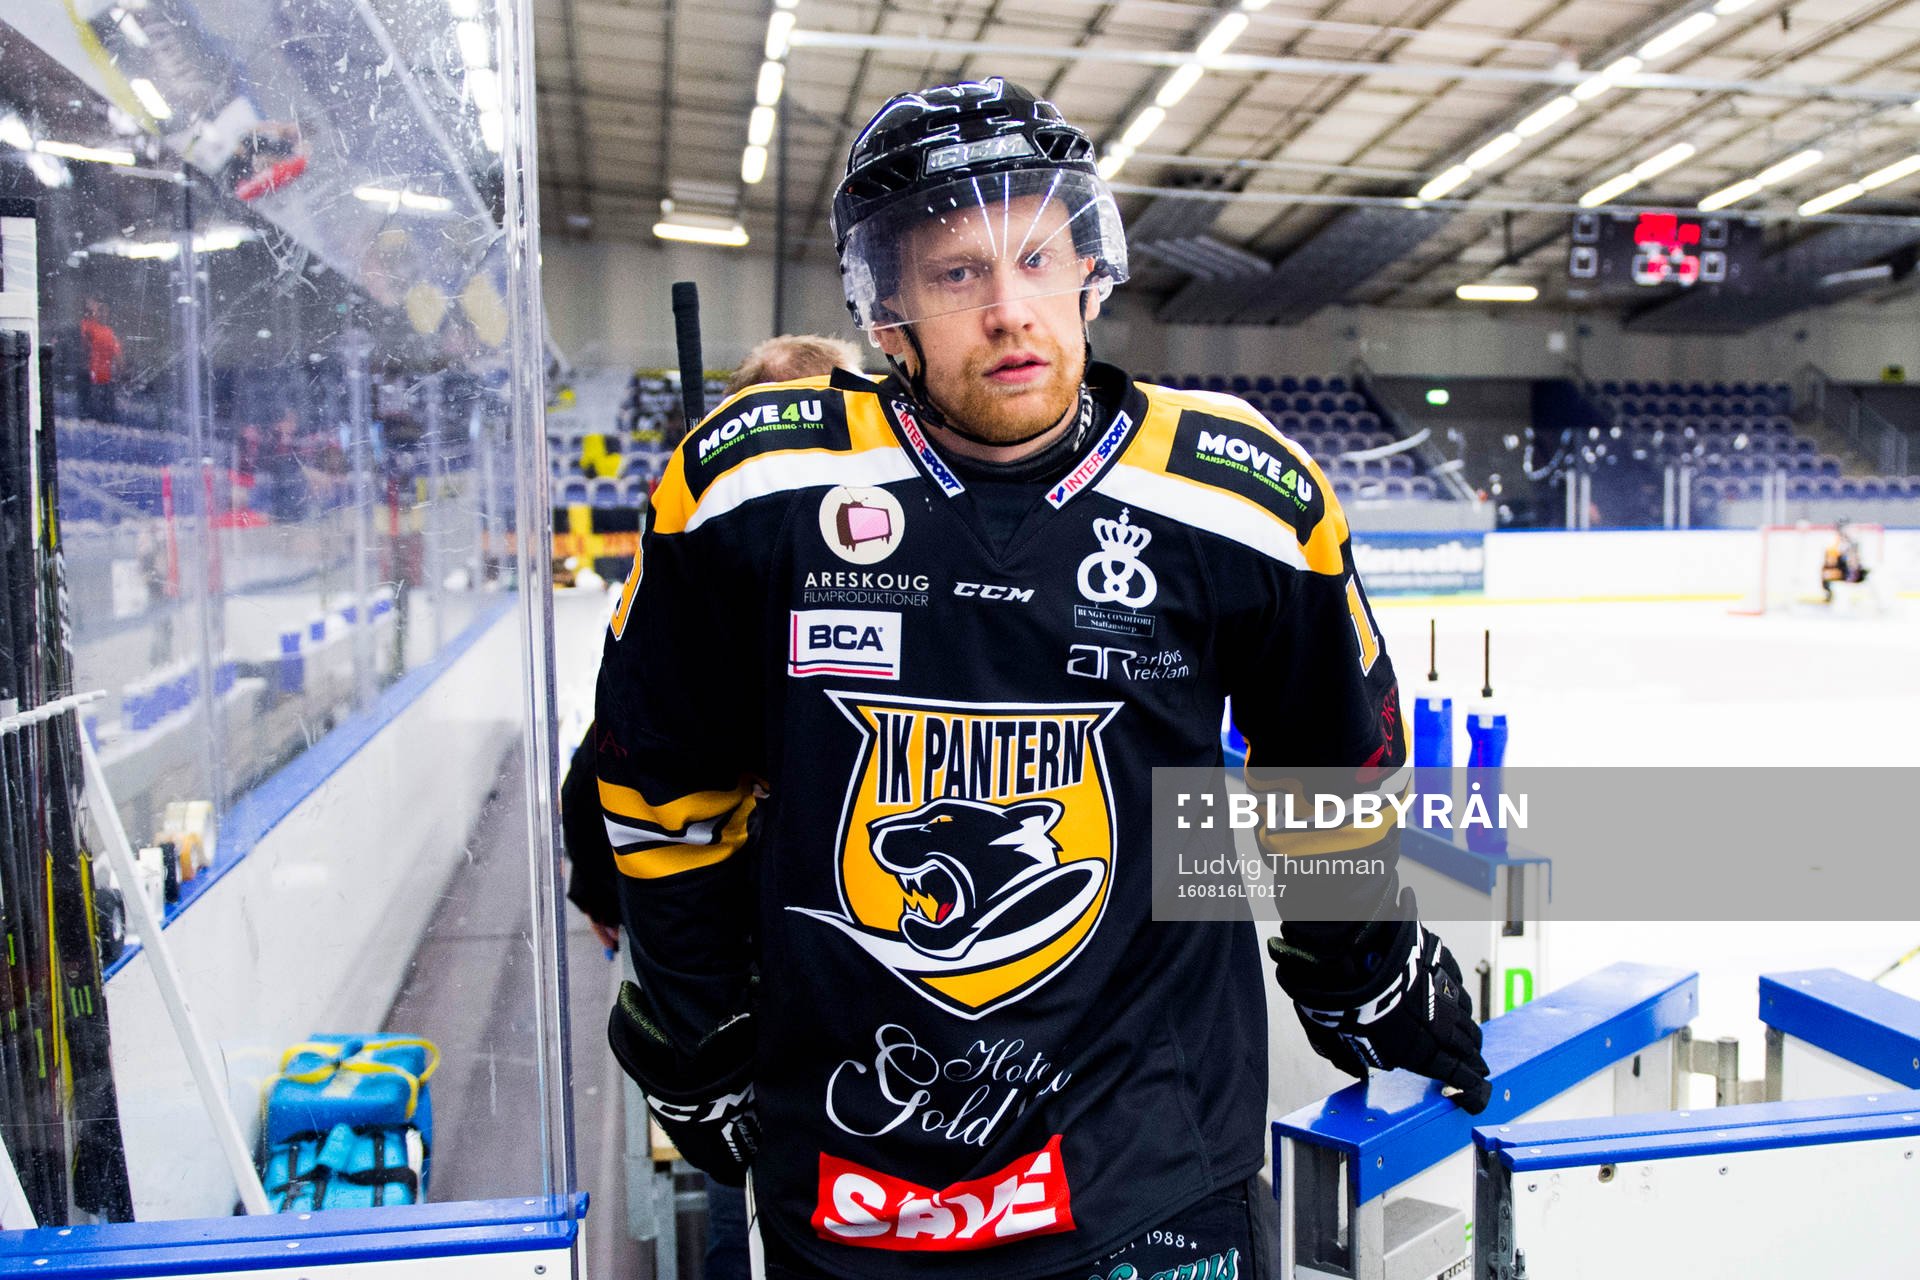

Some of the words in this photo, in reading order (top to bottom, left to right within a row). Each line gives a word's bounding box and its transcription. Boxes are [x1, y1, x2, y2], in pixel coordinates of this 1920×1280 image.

[698, 399, 823, 459] MOVE4U
[700, 433, 746, 466] TRANSPORTER
[749, 423, 798, 436] MONTERING
[899, 410, 962, 491] INTERSPORT
[1064, 414, 1127, 493] INTERSPORT
[1195, 451, 1250, 474] TRANSPORTER
[1252, 470, 1291, 499] MONTERING
[1196, 430, 1313, 502] MOVE4U
[803, 590, 929, 608] FILMPRODUKTIONER
[804, 571, 931, 592] ARESKOUG
[953, 581, 1035, 604] CCM
[808, 624, 884, 652] BCA
[1134, 664, 1189, 680] reklam
[872, 710, 915, 806] IK
[920, 715, 1091, 804] PANTERN
[1146, 1230, 1185, 1249] 1988
